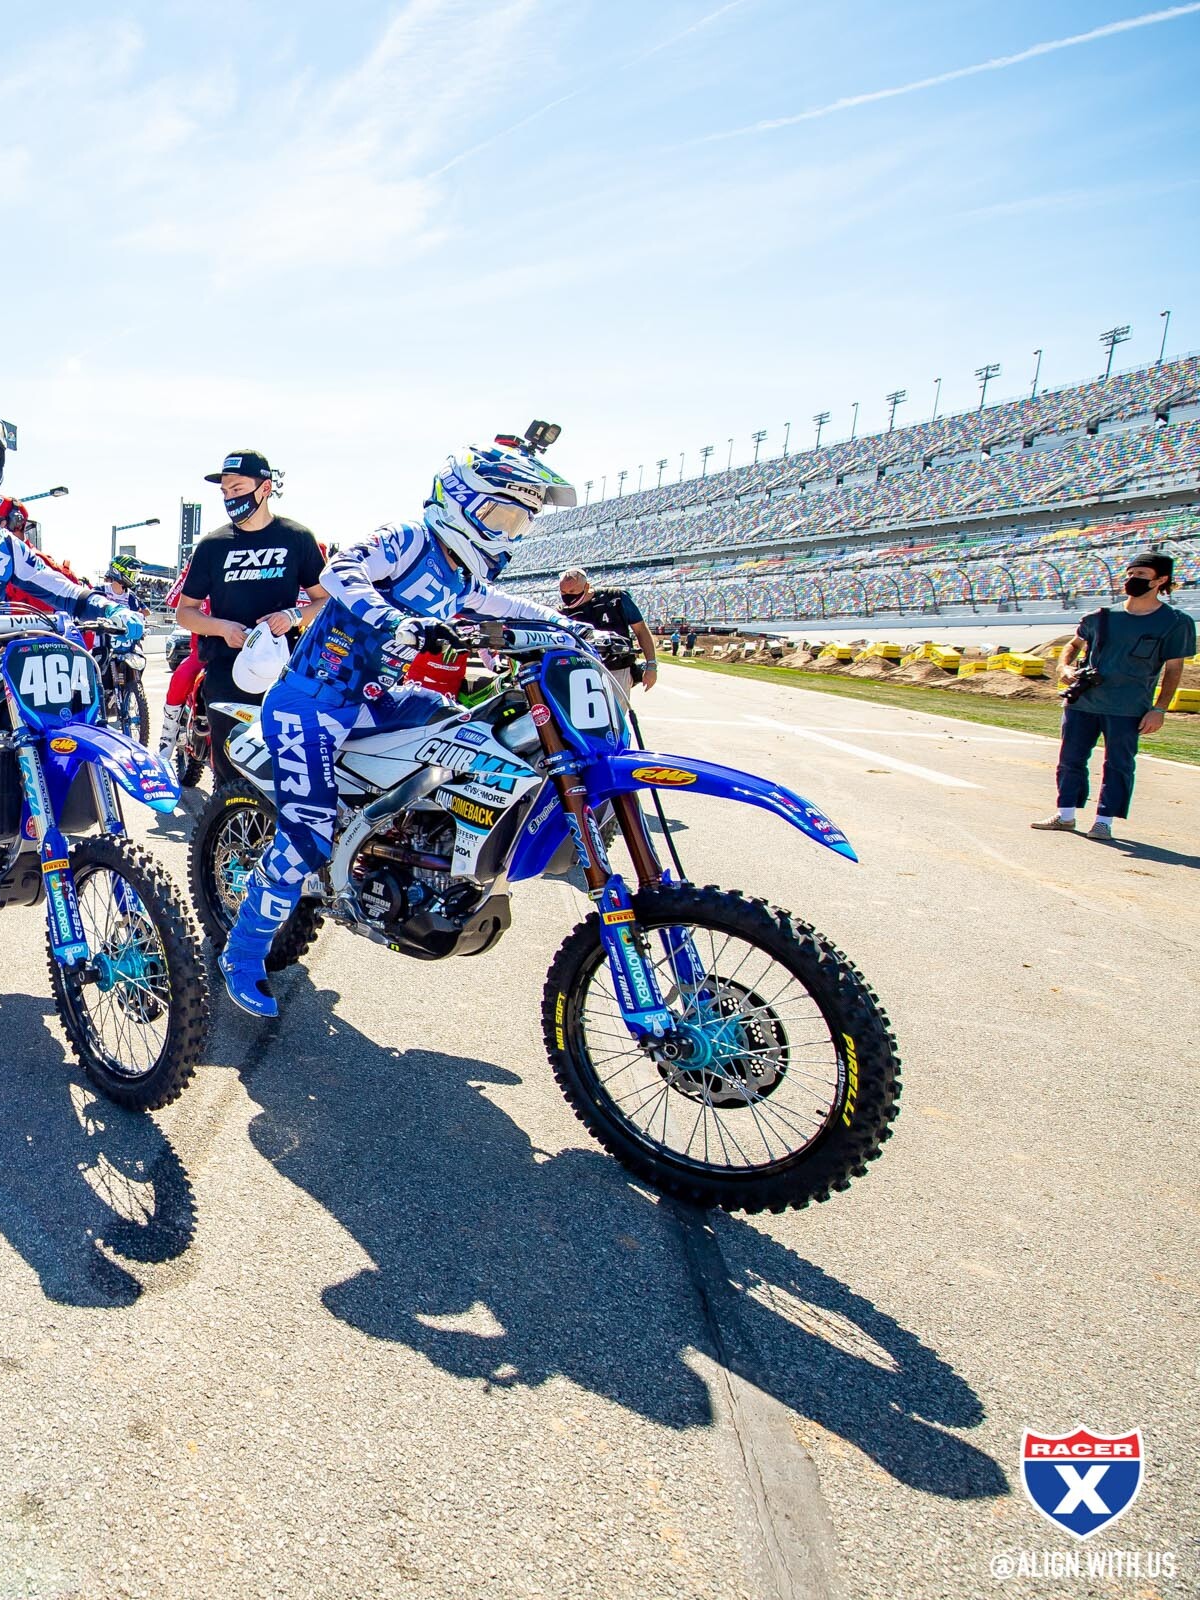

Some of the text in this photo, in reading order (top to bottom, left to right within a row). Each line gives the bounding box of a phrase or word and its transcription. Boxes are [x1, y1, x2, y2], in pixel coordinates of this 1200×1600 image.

[506, 482, 544, 502] CROW
[224, 548, 288, 569] FXR
[224, 566, 287, 583] CLUBMX
[400, 571, 457, 622] FX
[19, 654, 91, 707] 464
[230, 737, 272, 771] 61
[272, 710, 311, 797] FXR
[415, 738, 538, 794] CLUBMX
[633, 768, 697, 784] FMF
[225, 797, 259, 806] PIRELLI
[482, 790, 507, 805] MORE
[456, 827, 479, 840] EFFERY
[54, 891, 70, 940] MOTOREX
[626, 945, 653, 1006] MOTOREX
[842, 1032, 860, 1128] PIRELLI
